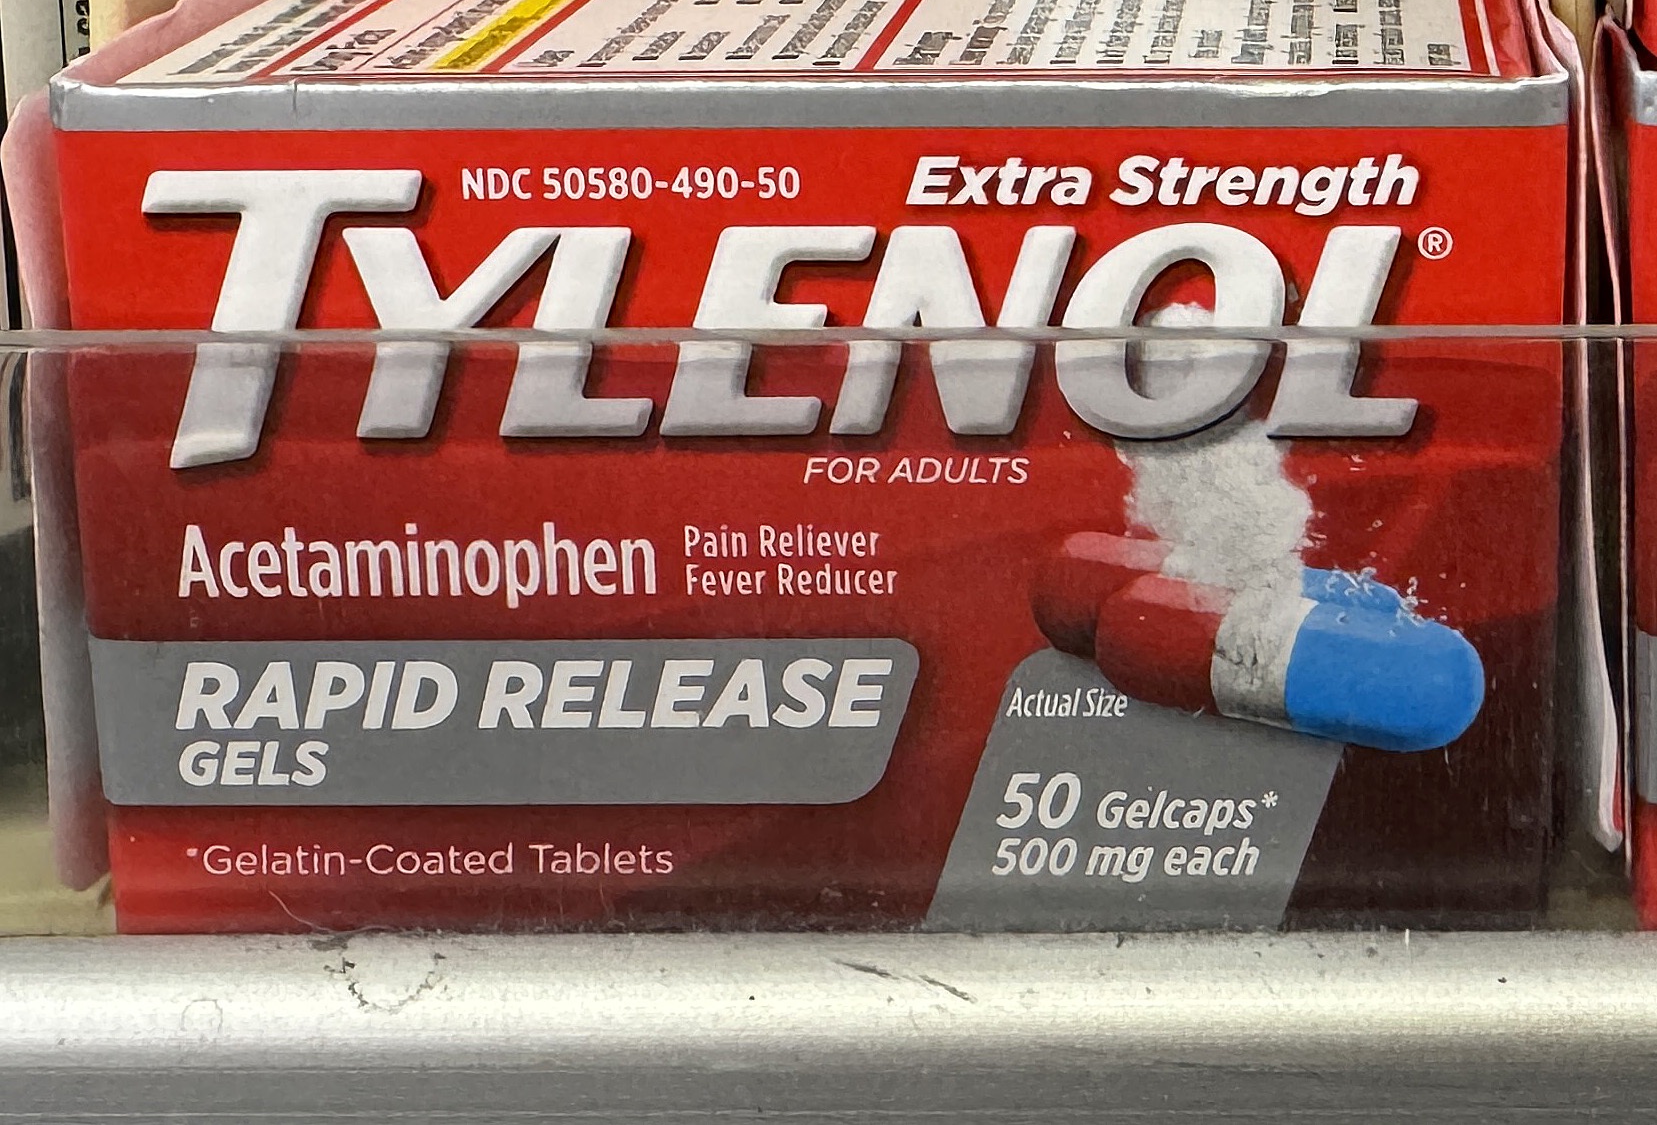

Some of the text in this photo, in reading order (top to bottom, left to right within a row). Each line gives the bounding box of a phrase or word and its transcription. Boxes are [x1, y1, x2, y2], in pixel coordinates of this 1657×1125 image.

[462, 166, 801, 201] NDC 50580-490-50
[906, 152, 1420, 217] Extra Strength
[804, 456, 1031, 485] FOR ADULTS
[683, 524, 880, 559] Pain Reliever
[178, 521, 656, 609] Acetaminophen
[685, 564, 897, 596] Fever Reducer
[175, 658, 893, 731] RAPID RELEASE
[1006, 687, 1128, 719] Actual Size
[177, 741, 329, 787] GELS
[996, 772, 1081, 830] 50
[529, 843, 674, 875] Tablets
[992, 837, 1260, 882] 500 mg each
